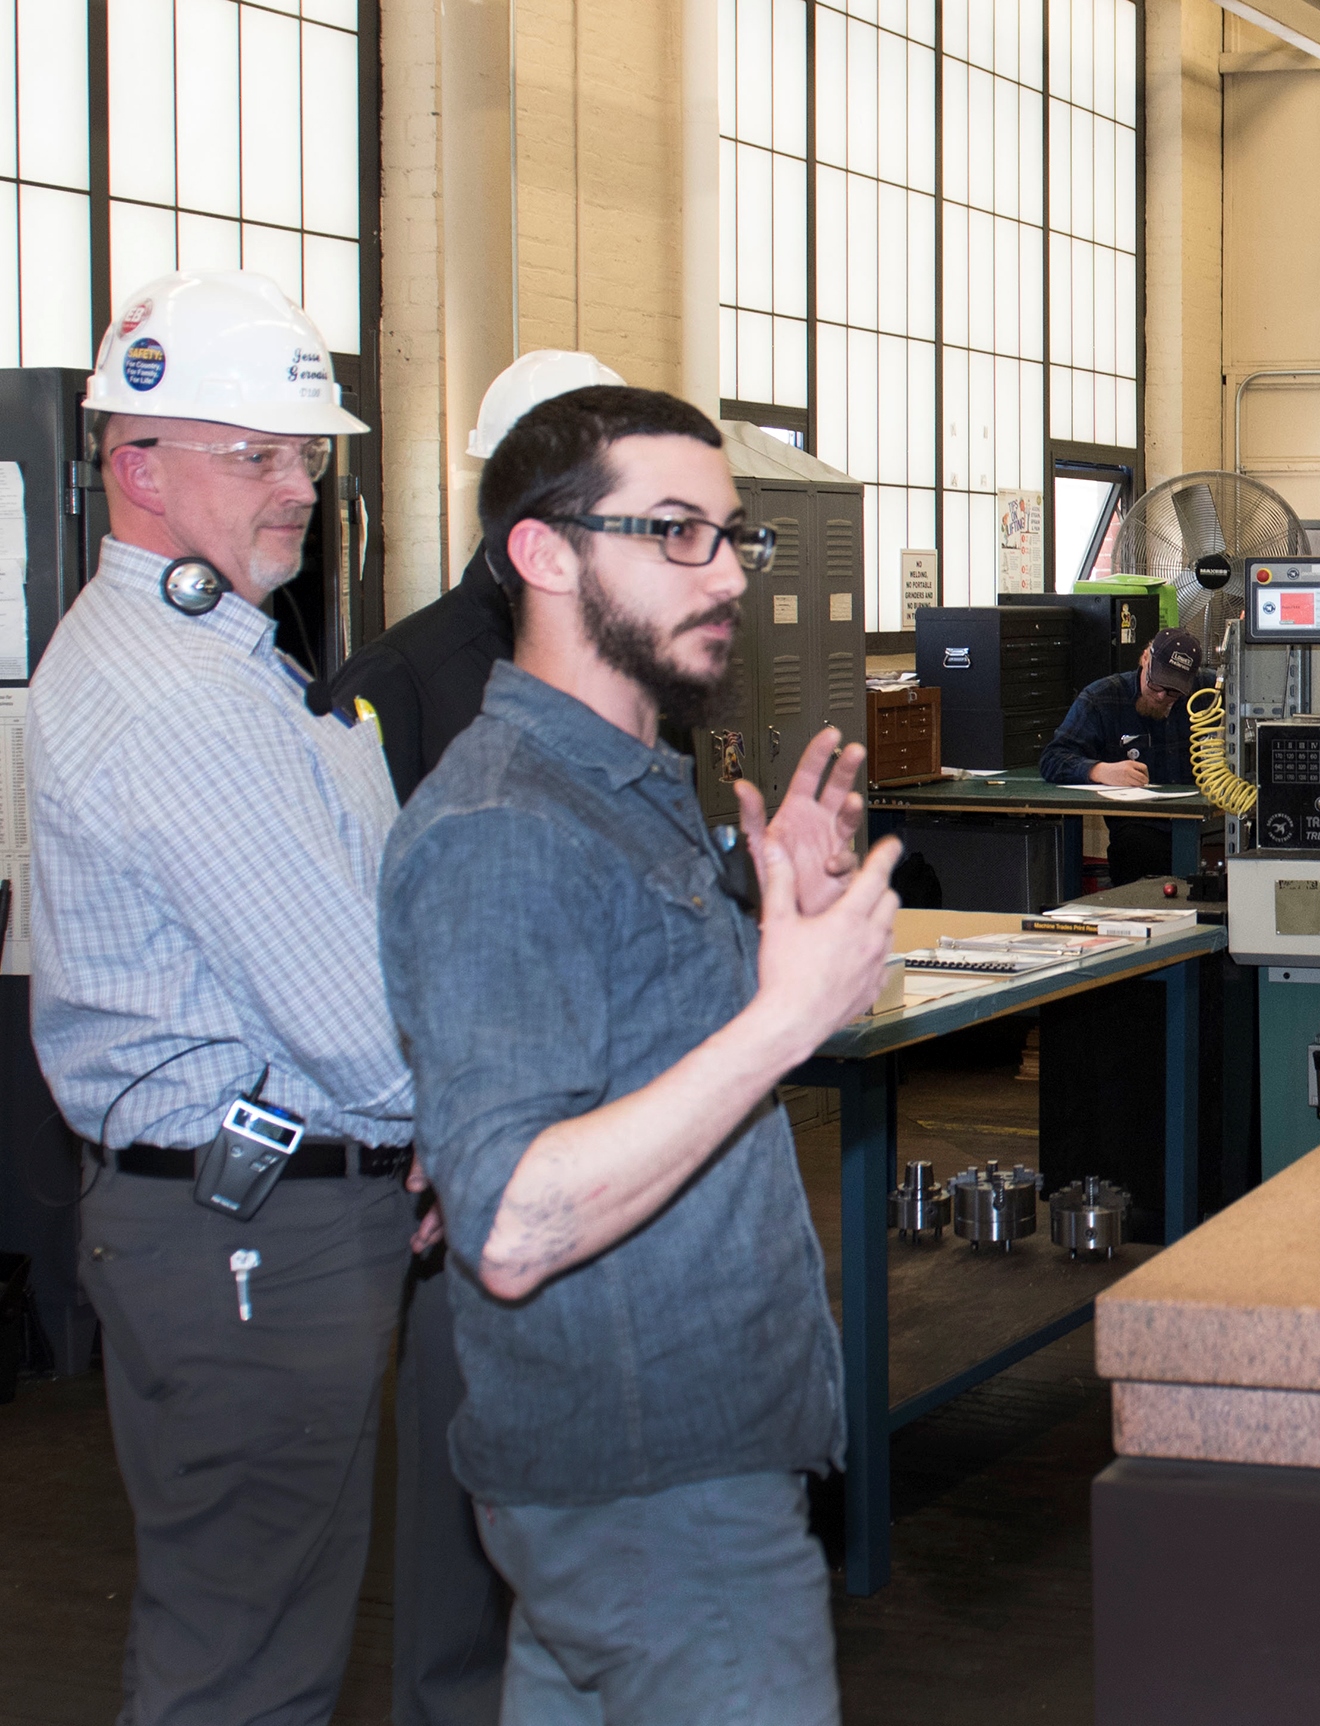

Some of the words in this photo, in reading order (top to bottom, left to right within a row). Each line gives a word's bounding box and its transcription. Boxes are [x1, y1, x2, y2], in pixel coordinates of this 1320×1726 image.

[913, 581, 932, 589] PORTABLE
[905, 591, 924, 599] GRINDERS
[1056, 923, 1072, 931] Trades
